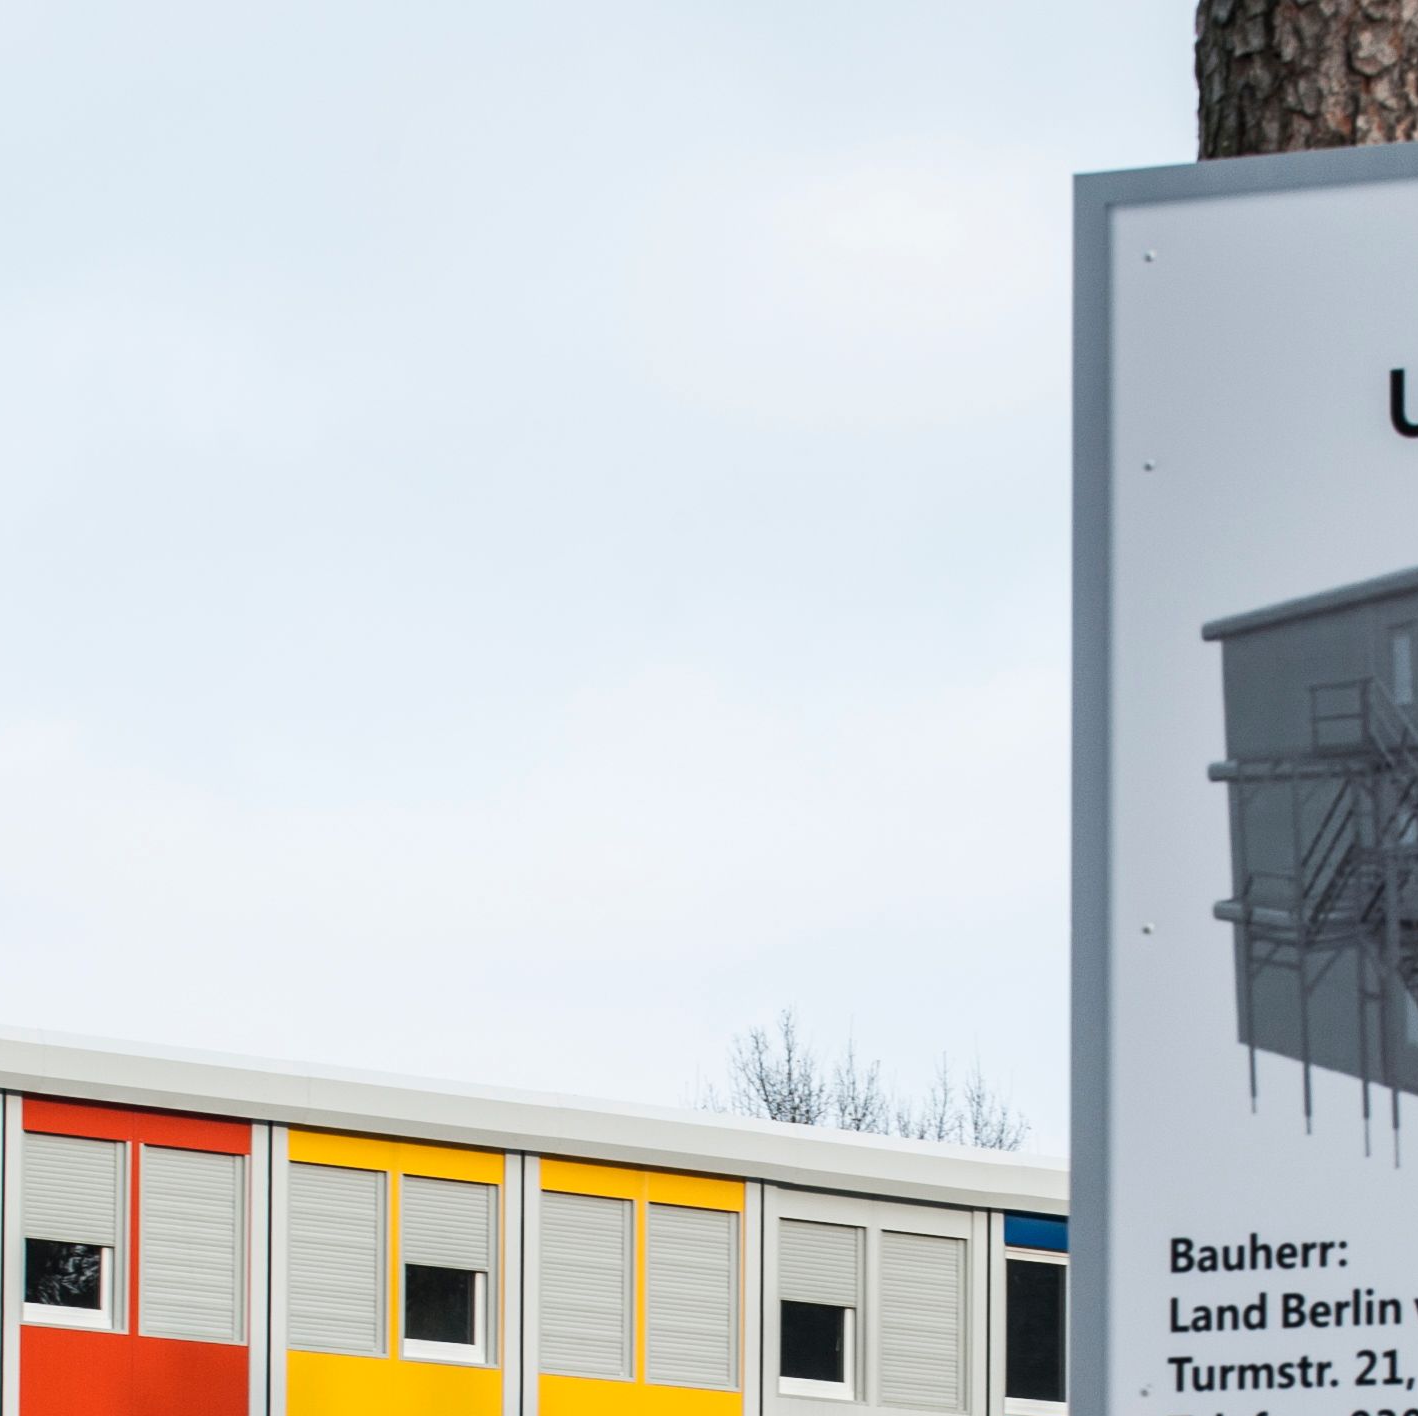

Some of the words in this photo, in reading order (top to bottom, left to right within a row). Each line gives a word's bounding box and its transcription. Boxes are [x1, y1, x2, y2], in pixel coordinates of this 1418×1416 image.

[1170, 1232, 1348, 1274] Bauherr:
[1170, 1293, 1267, 1334] Land
[1281, 1288, 1402, 1329] Berlin
[1167, 1355, 1339, 1393] Turmstr.
[1354, 1349, 1415, 1391] 21,
